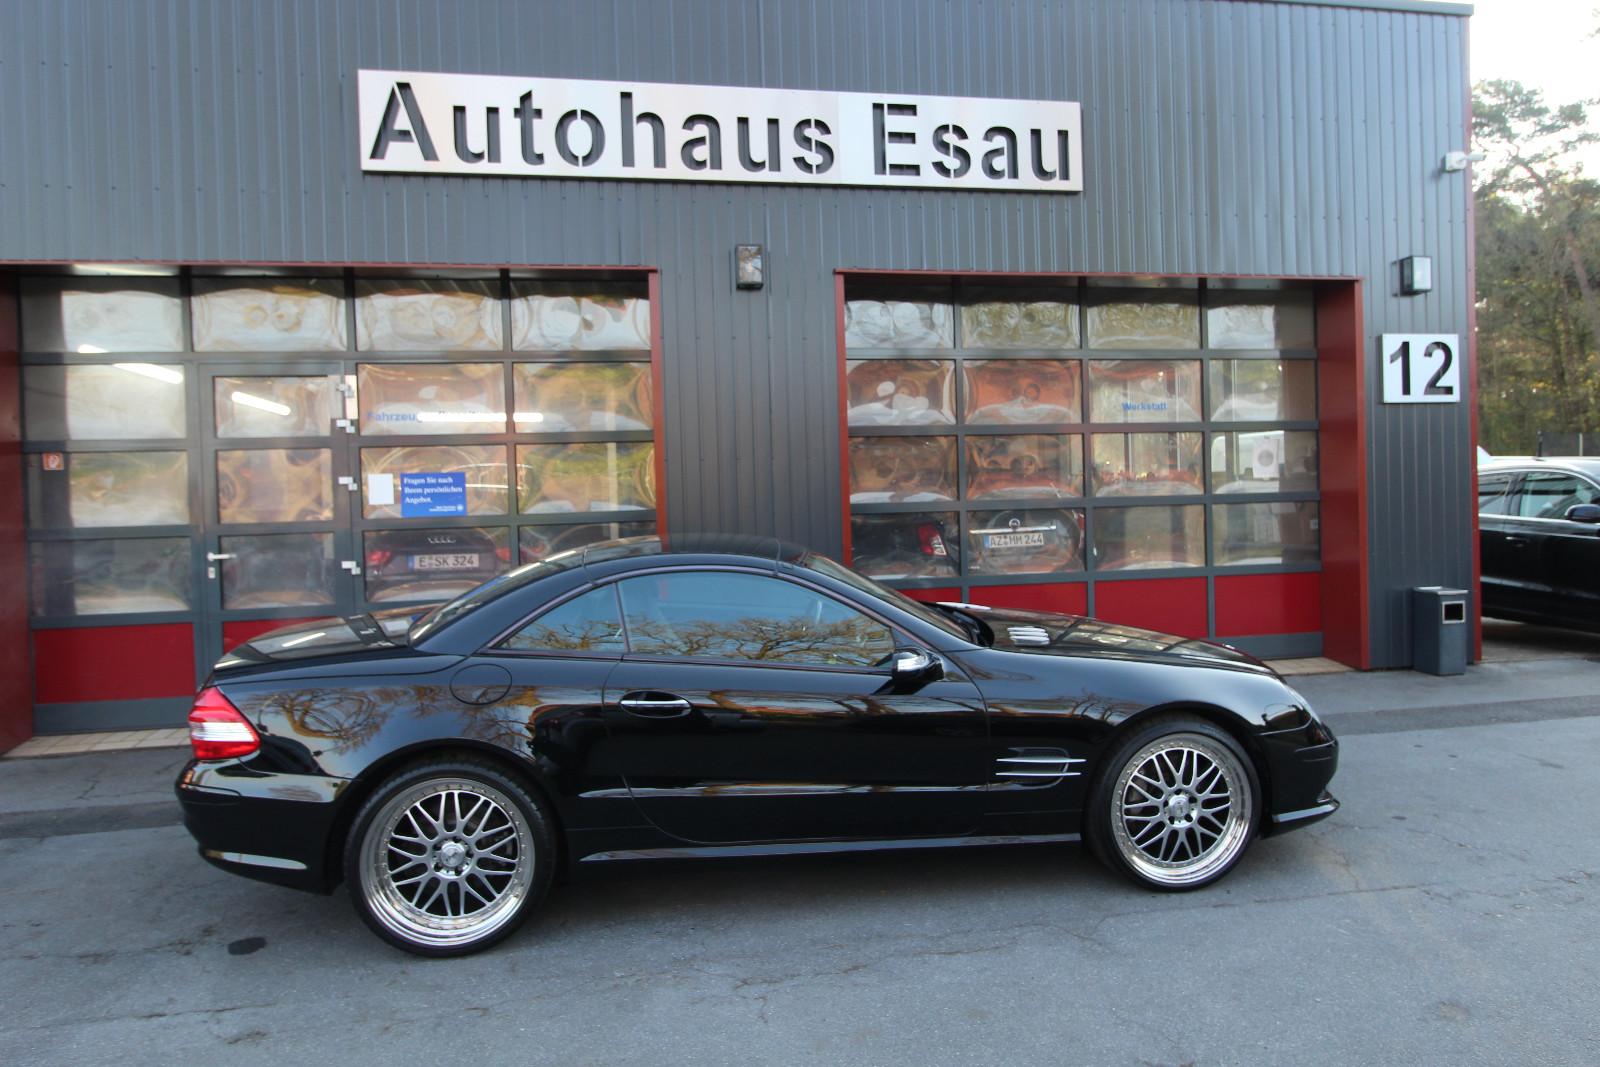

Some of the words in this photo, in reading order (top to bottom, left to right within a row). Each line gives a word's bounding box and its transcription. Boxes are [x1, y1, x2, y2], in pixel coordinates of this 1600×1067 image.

[369, 81, 835, 175] Autohaus
[872, 102, 1070, 181] Esau
[1389, 341, 1454, 396] 12
[1121, 401, 1168, 410] Werkstatt
[1023, 534, 1043, 545] 244
